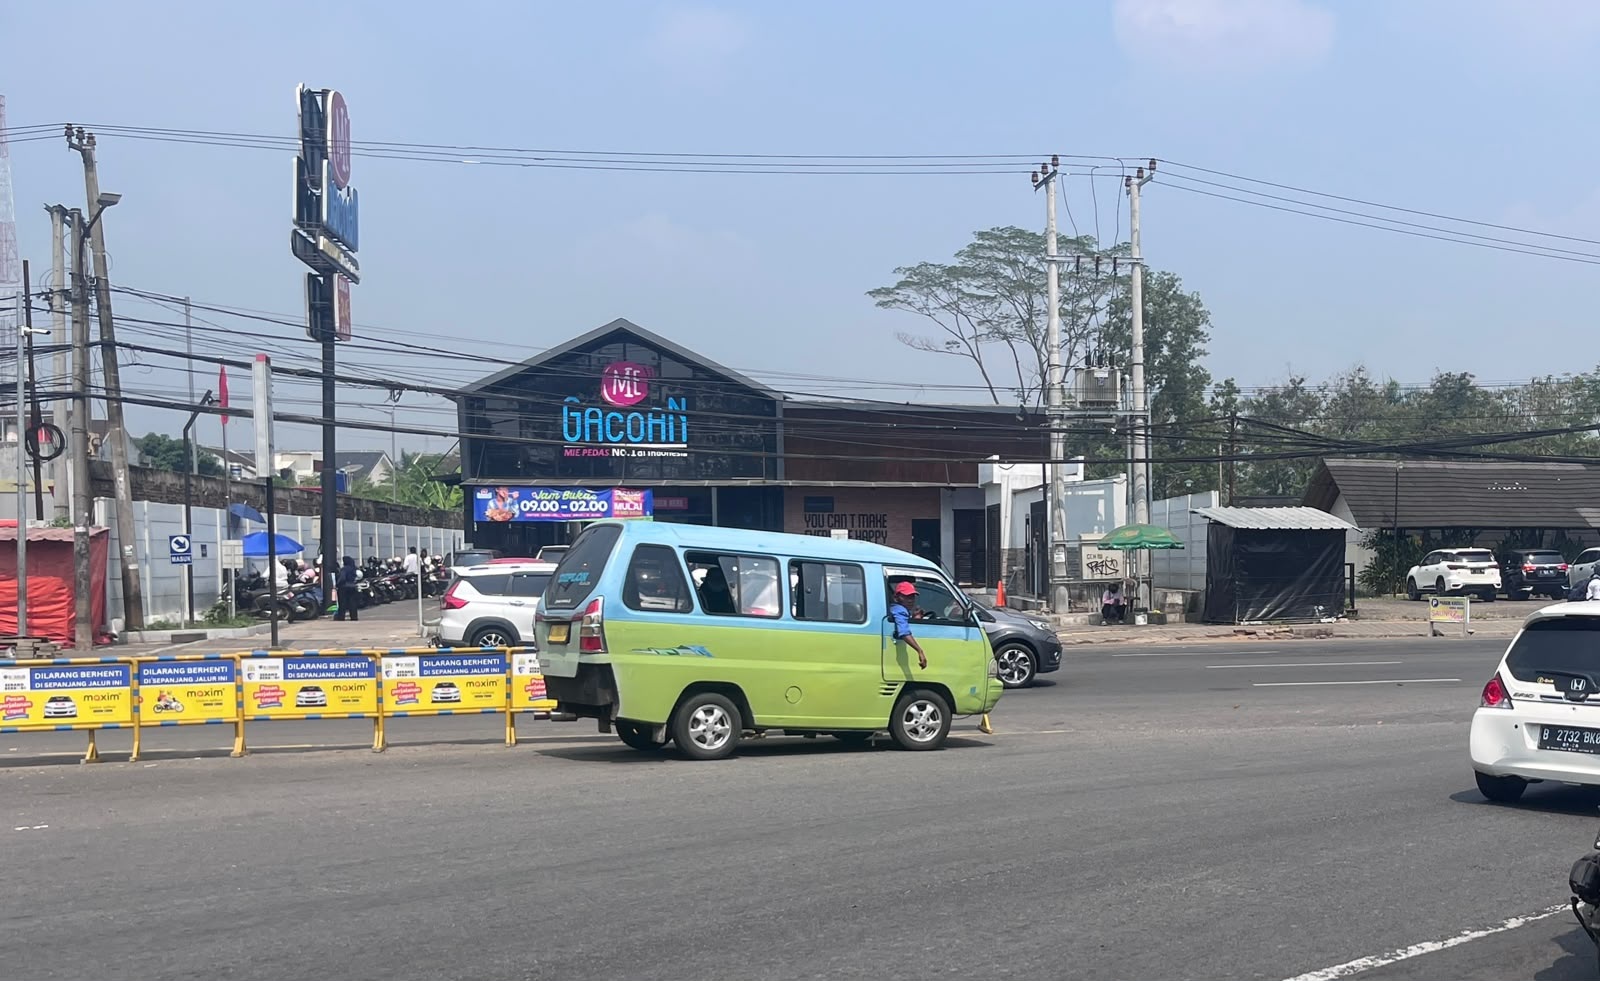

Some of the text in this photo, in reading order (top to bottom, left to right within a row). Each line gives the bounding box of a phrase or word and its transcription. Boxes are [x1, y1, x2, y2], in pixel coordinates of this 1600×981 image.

[612, 367, 642, 398] MIE
[563, 396, 687, 442] GACOAN
[532, 490, 597, 500] Jam Buka
[521, 500, 559, 511] 09.00
[569, 500, 608, 512] 02.00
[614, 502, 642, 511] MULAI
[804, 514, 824, 528] YOU
[858, 514, 887, 528] MAKE
[463, 658, 499, 666] BERHENTI
[187, 666, 227, 674] BERHENTI
[34, 671, 78, 680] DILARANG
[80, 670, 122, 678] BERHENTI
[333, 683, 366, 692] maxim
[466, 679, 497, 687] maxim
[83, 693, 119, 701] maxim
[187, 688, 223, 697] maxim
[1543, 728, 1549, 740] B
[1556, 729, 1580, 743] 2732
